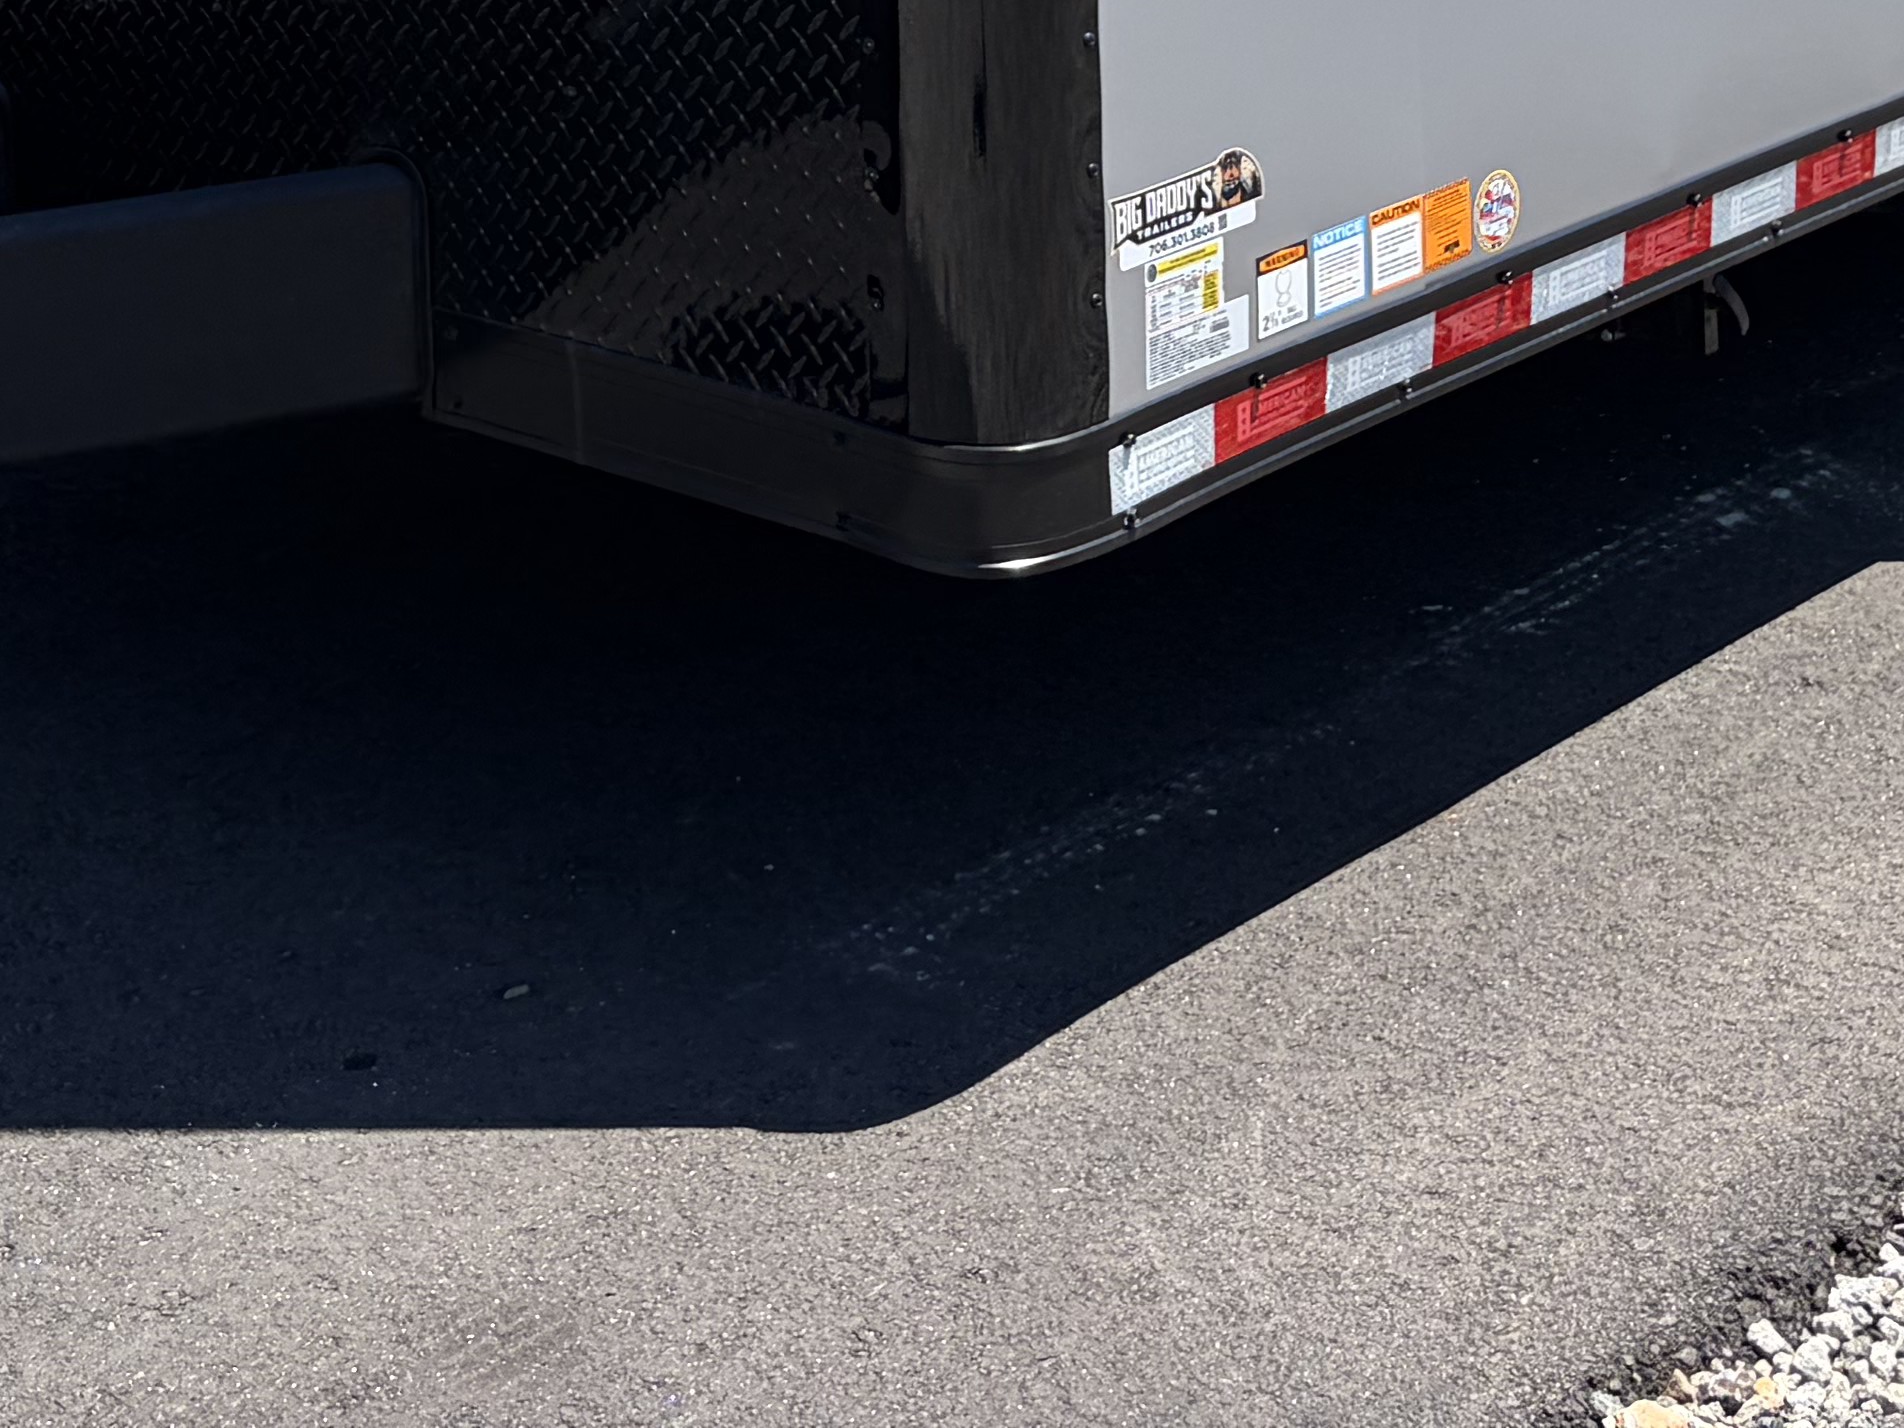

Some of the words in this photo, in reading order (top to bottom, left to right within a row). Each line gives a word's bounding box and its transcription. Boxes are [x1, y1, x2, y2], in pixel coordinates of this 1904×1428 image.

[1114, 196, 1143, 244] BIG
[1146, 169, 1214, 222] DADDY'S
[1371, 198, 1421, 225] CAUTION
[1136, 211, 1194, 240] TRAILERS
[1313, 219, 1362, 249] NOTICE
